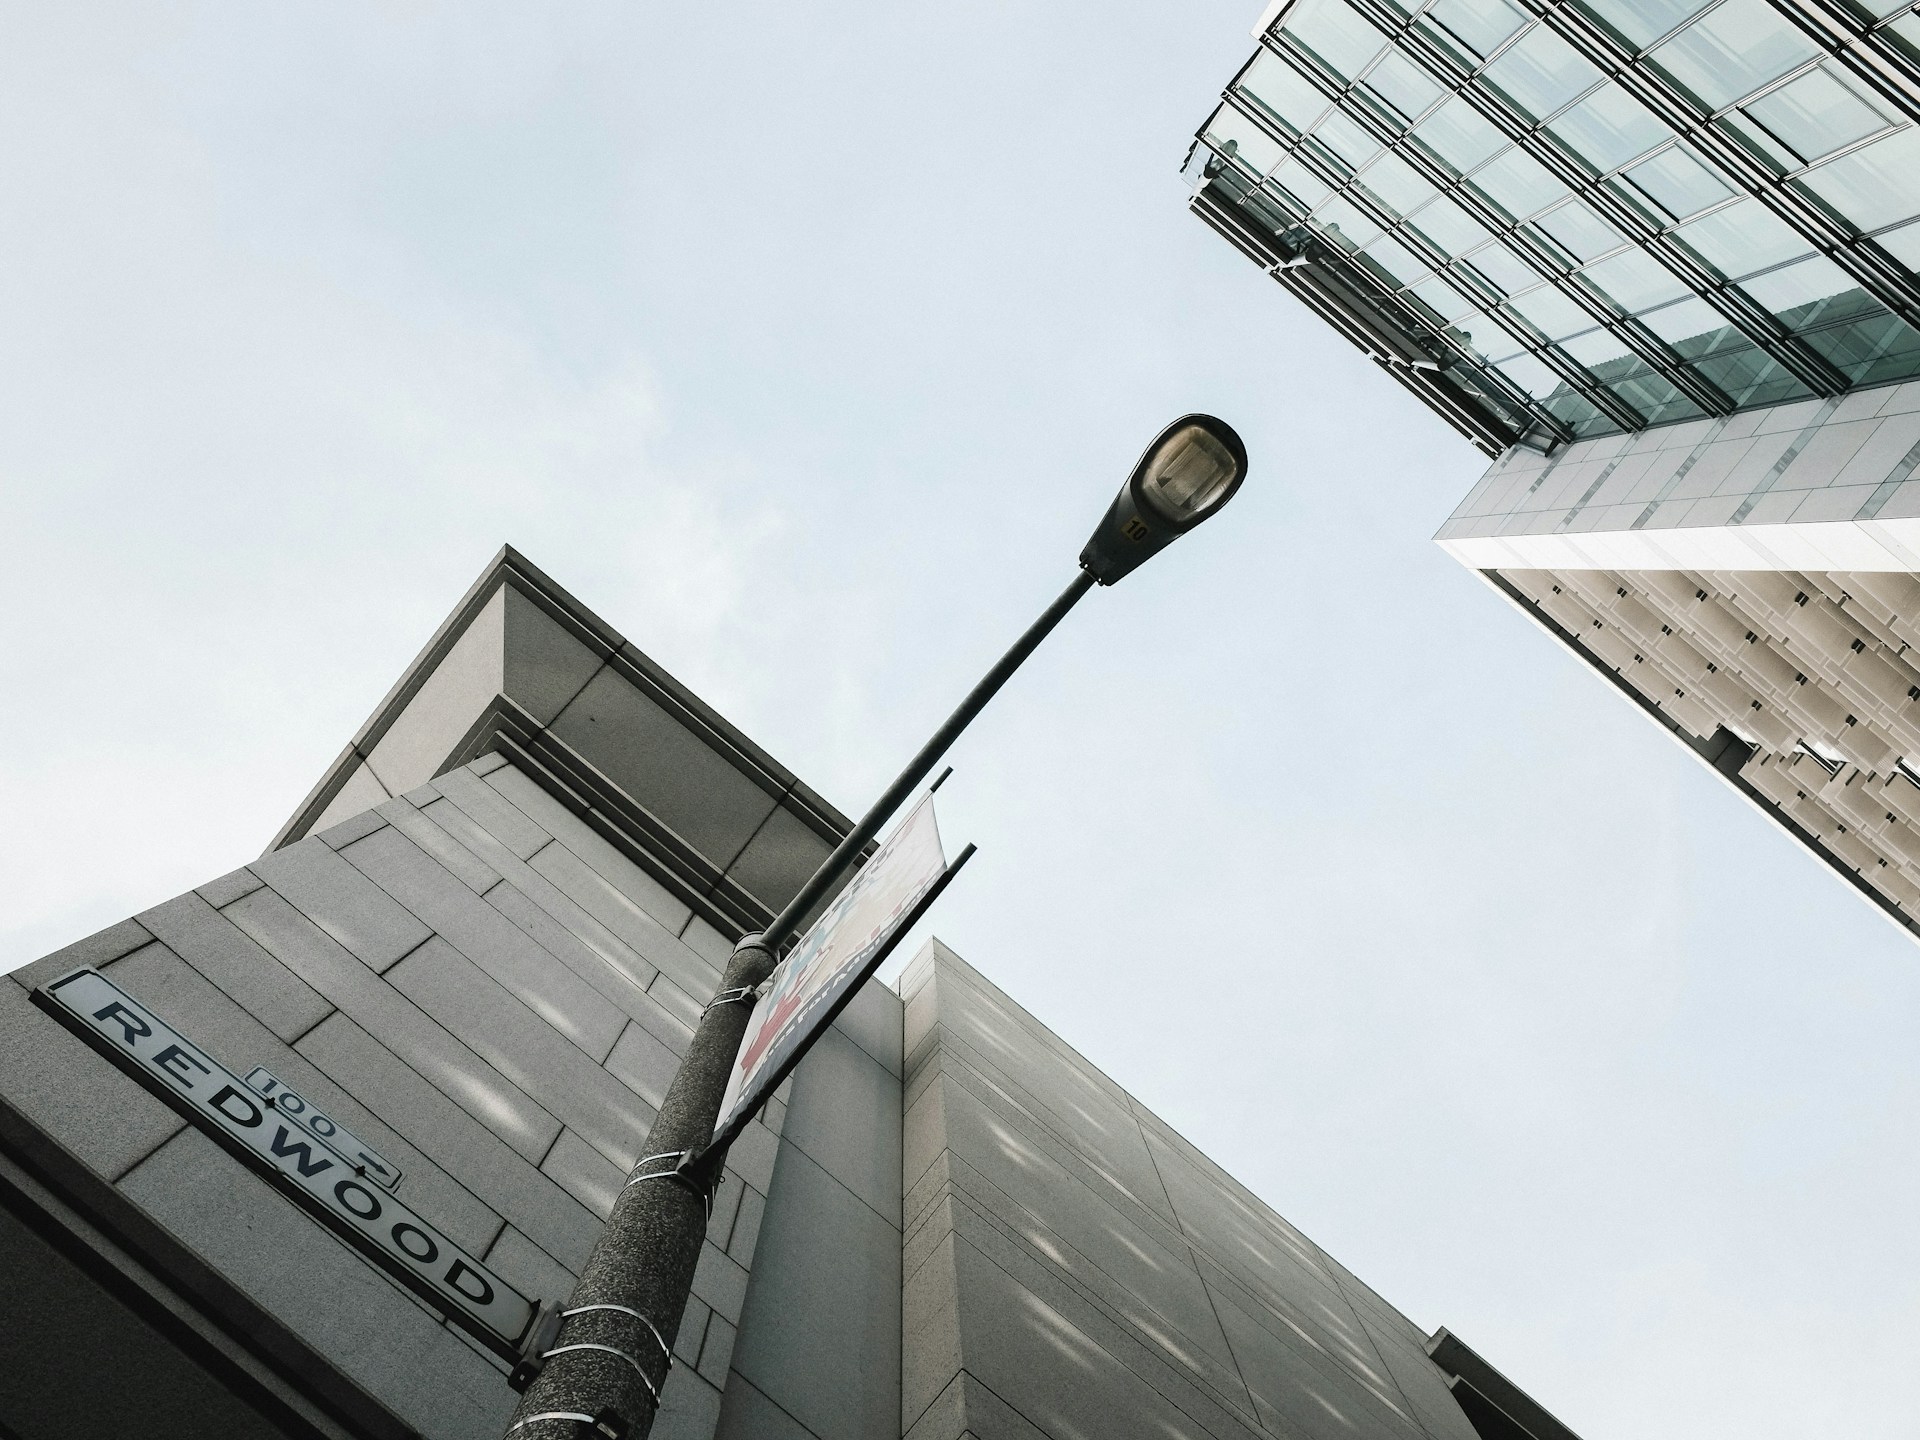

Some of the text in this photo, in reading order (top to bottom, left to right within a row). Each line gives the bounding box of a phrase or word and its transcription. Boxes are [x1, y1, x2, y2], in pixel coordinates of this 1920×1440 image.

[1127, 520, 1148, 541] 10
[262, 1077, 336, 1138] 100
[92, 1001, 494, 1306] REDWOOD
